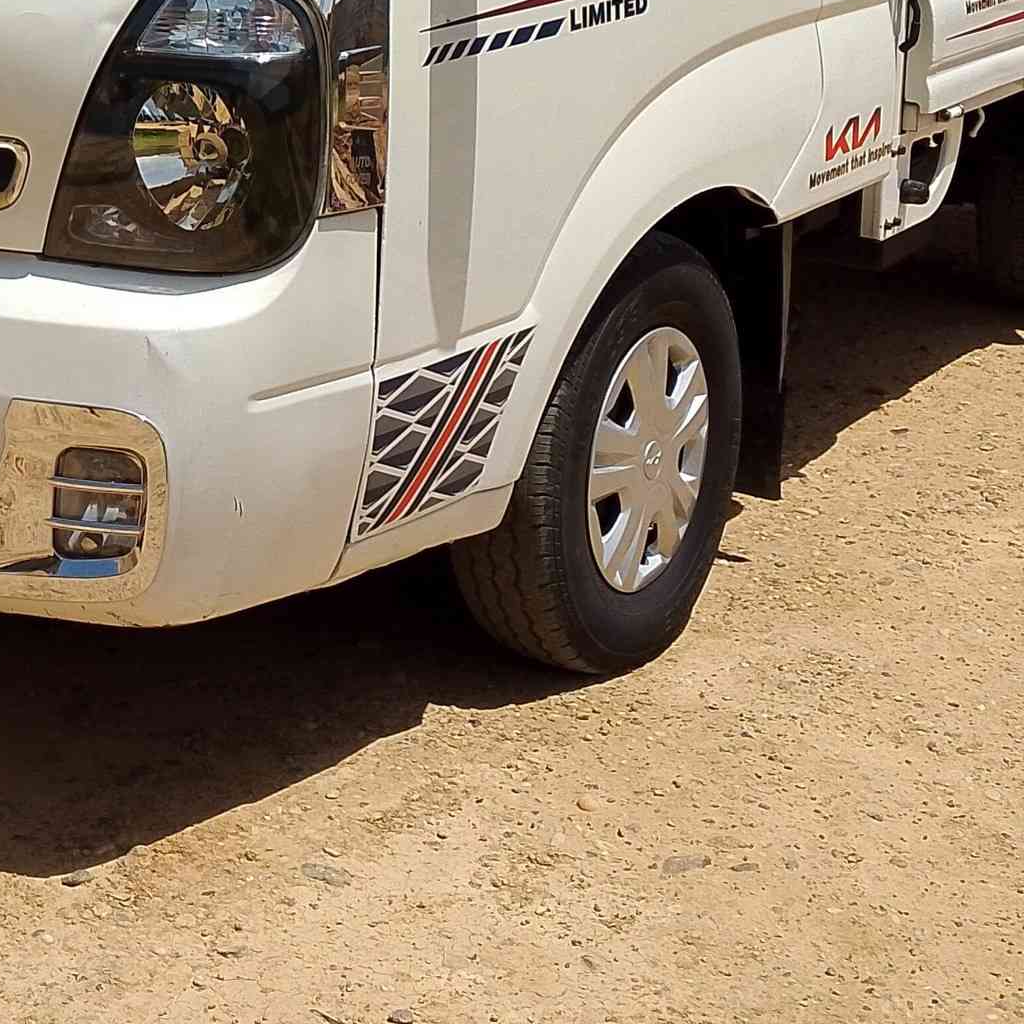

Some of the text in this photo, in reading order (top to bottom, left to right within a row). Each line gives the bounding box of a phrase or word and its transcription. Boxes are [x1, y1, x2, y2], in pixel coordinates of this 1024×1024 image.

[824, 106, 882, 162] KIA
[808, 158, 849, 190] Movement
[850, 151, 866, 171] that
